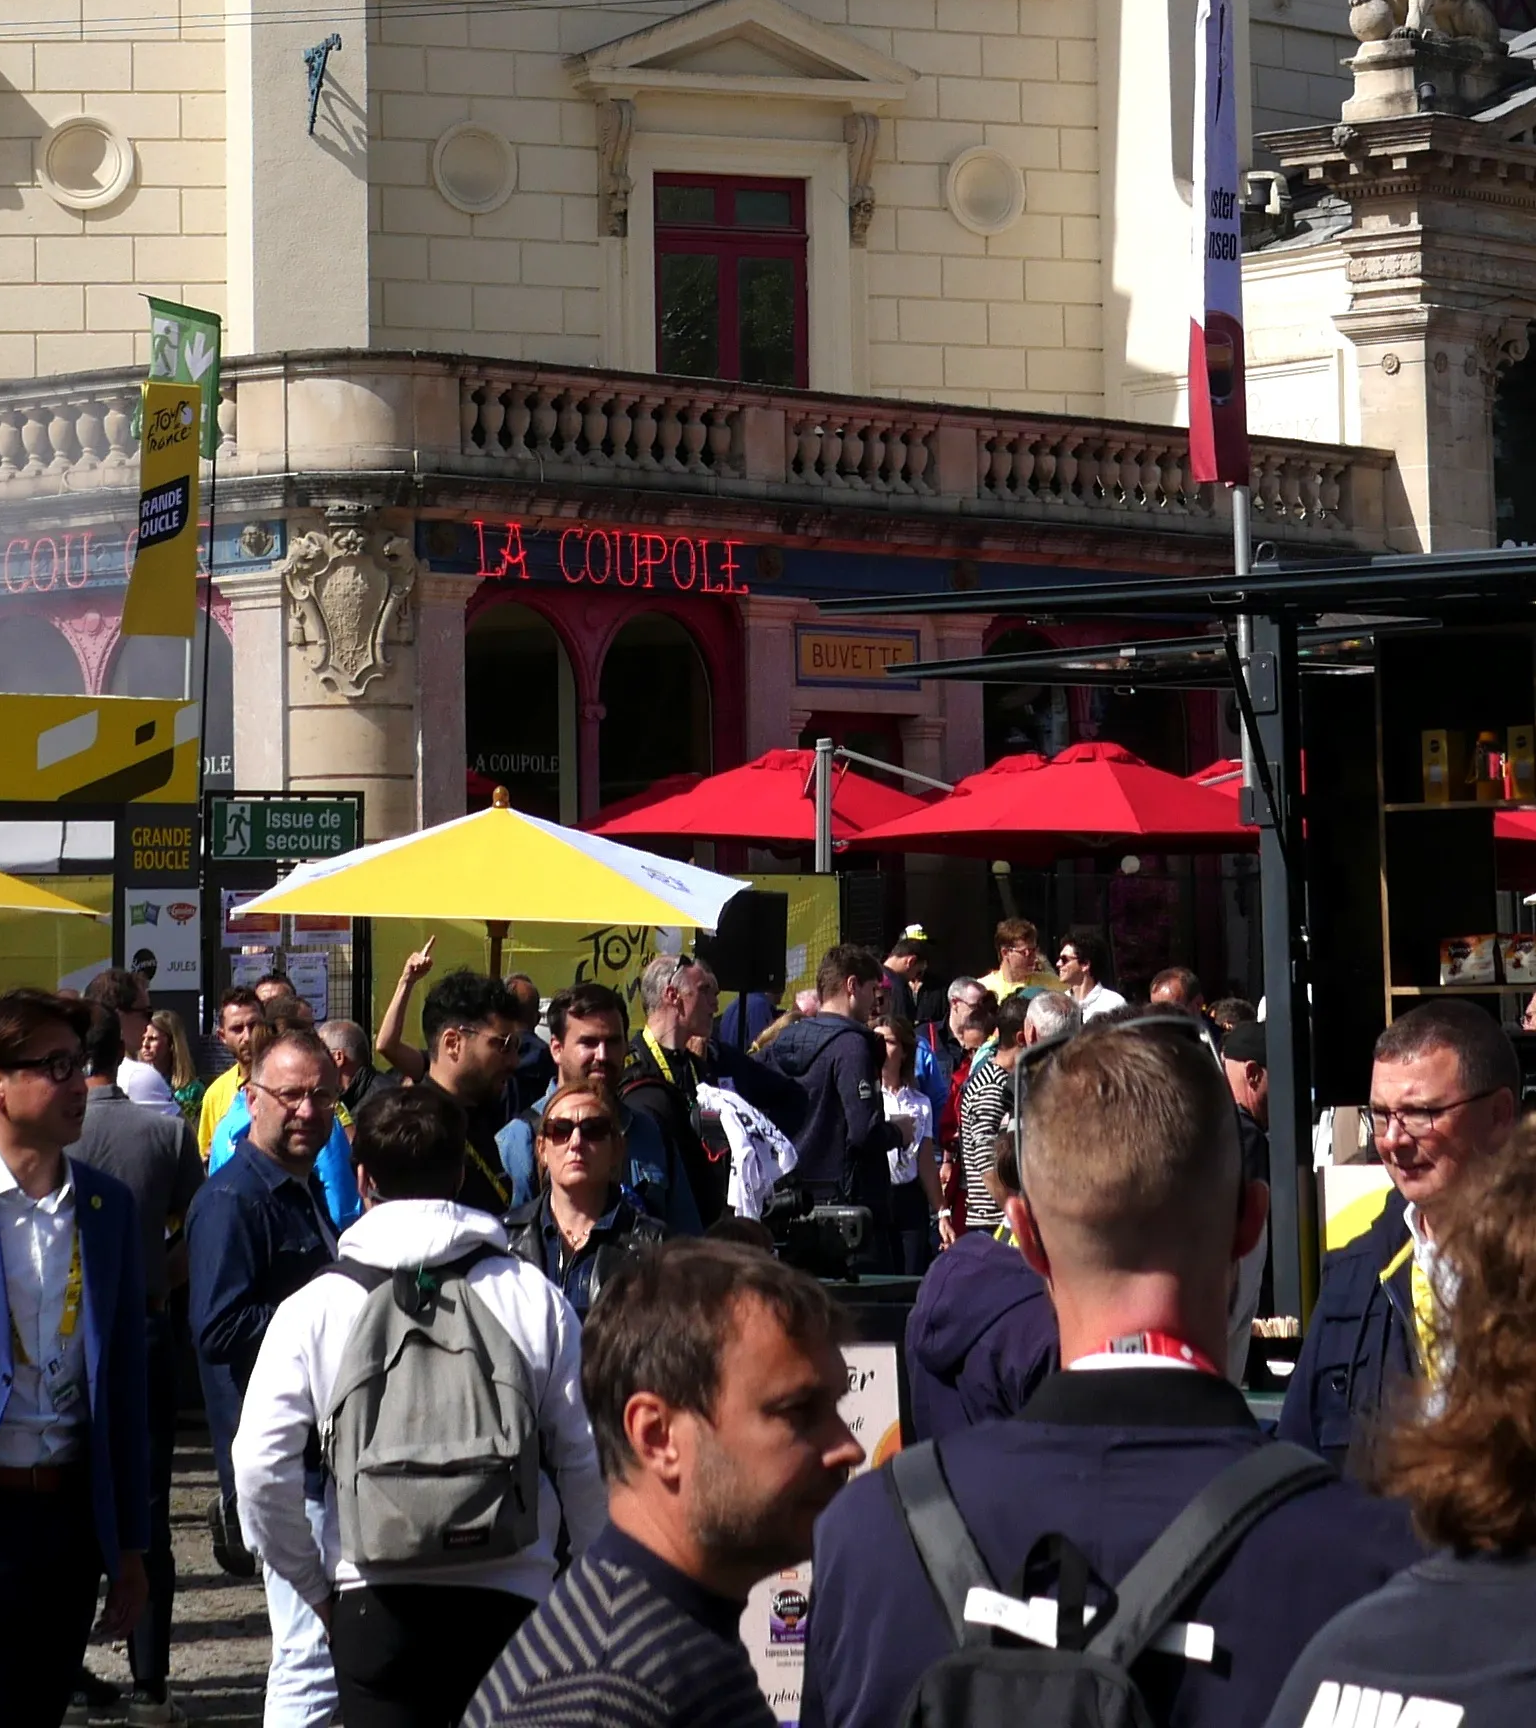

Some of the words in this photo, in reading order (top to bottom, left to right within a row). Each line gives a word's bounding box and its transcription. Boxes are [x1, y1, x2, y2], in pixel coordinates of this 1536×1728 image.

[1208, 231, 1237, 261] nseo
[142, 487, 183, 517] RANDE
[140, 511, 179, 539] OUCLE
[472, 520, 530, 579] LA
[559, 527, 750, 594] COUPOLE
[811, 643, 902, 670] BUVETTE
[489, 753, 559, 773] COUPOLE
[266, 808, 314, 829] Issue
[319, 808, 341, 828] de
[131, 827, 192, 847] GRANDE
[265, 833, 342, 850] secours
[133, 850, 190, 870] BOUCLE
[167, 961, 197, 972] JULES
